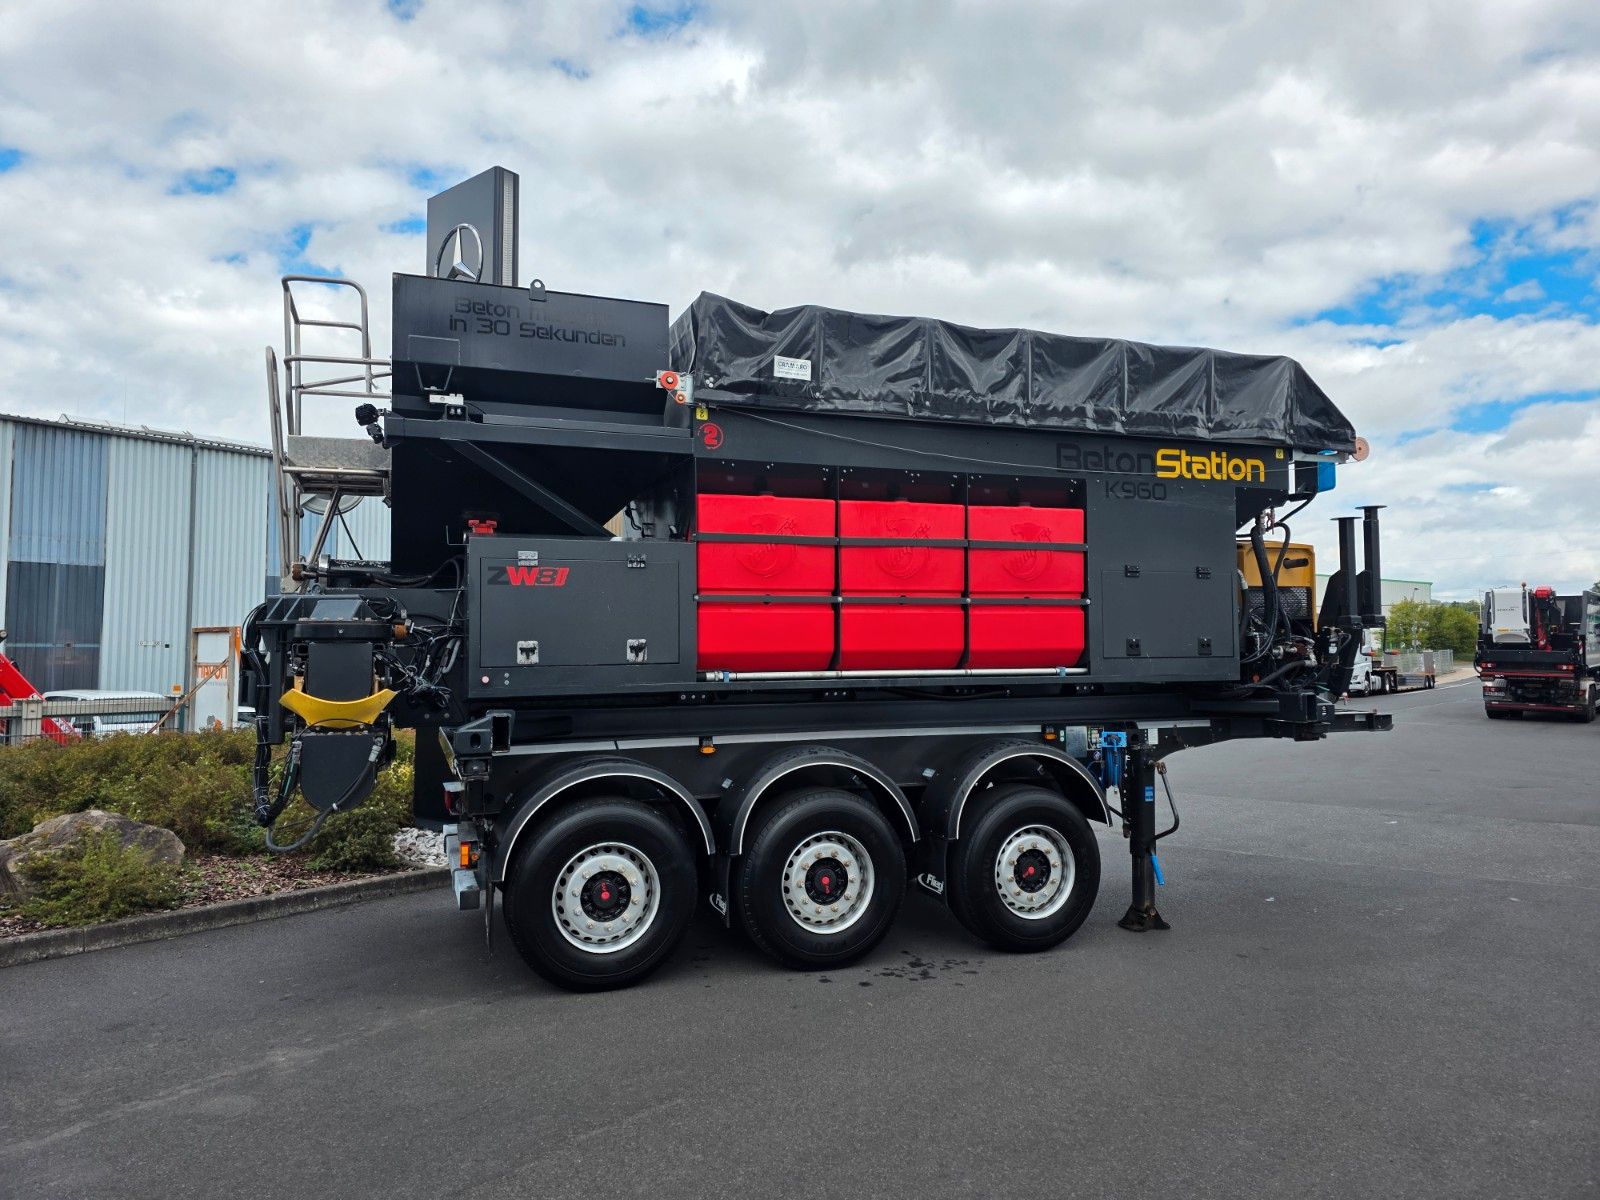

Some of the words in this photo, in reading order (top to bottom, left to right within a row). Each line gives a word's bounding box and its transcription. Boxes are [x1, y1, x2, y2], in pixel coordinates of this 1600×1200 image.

[454, 296, 521, 319] Beton
[449, 314, 468, 333] in
[476, 317, 511, 336] 30
[519, 322, 627, 348] Sekunden
[703, 425, 718, 445] 2
[1105, 480, 1168, 502] K960
